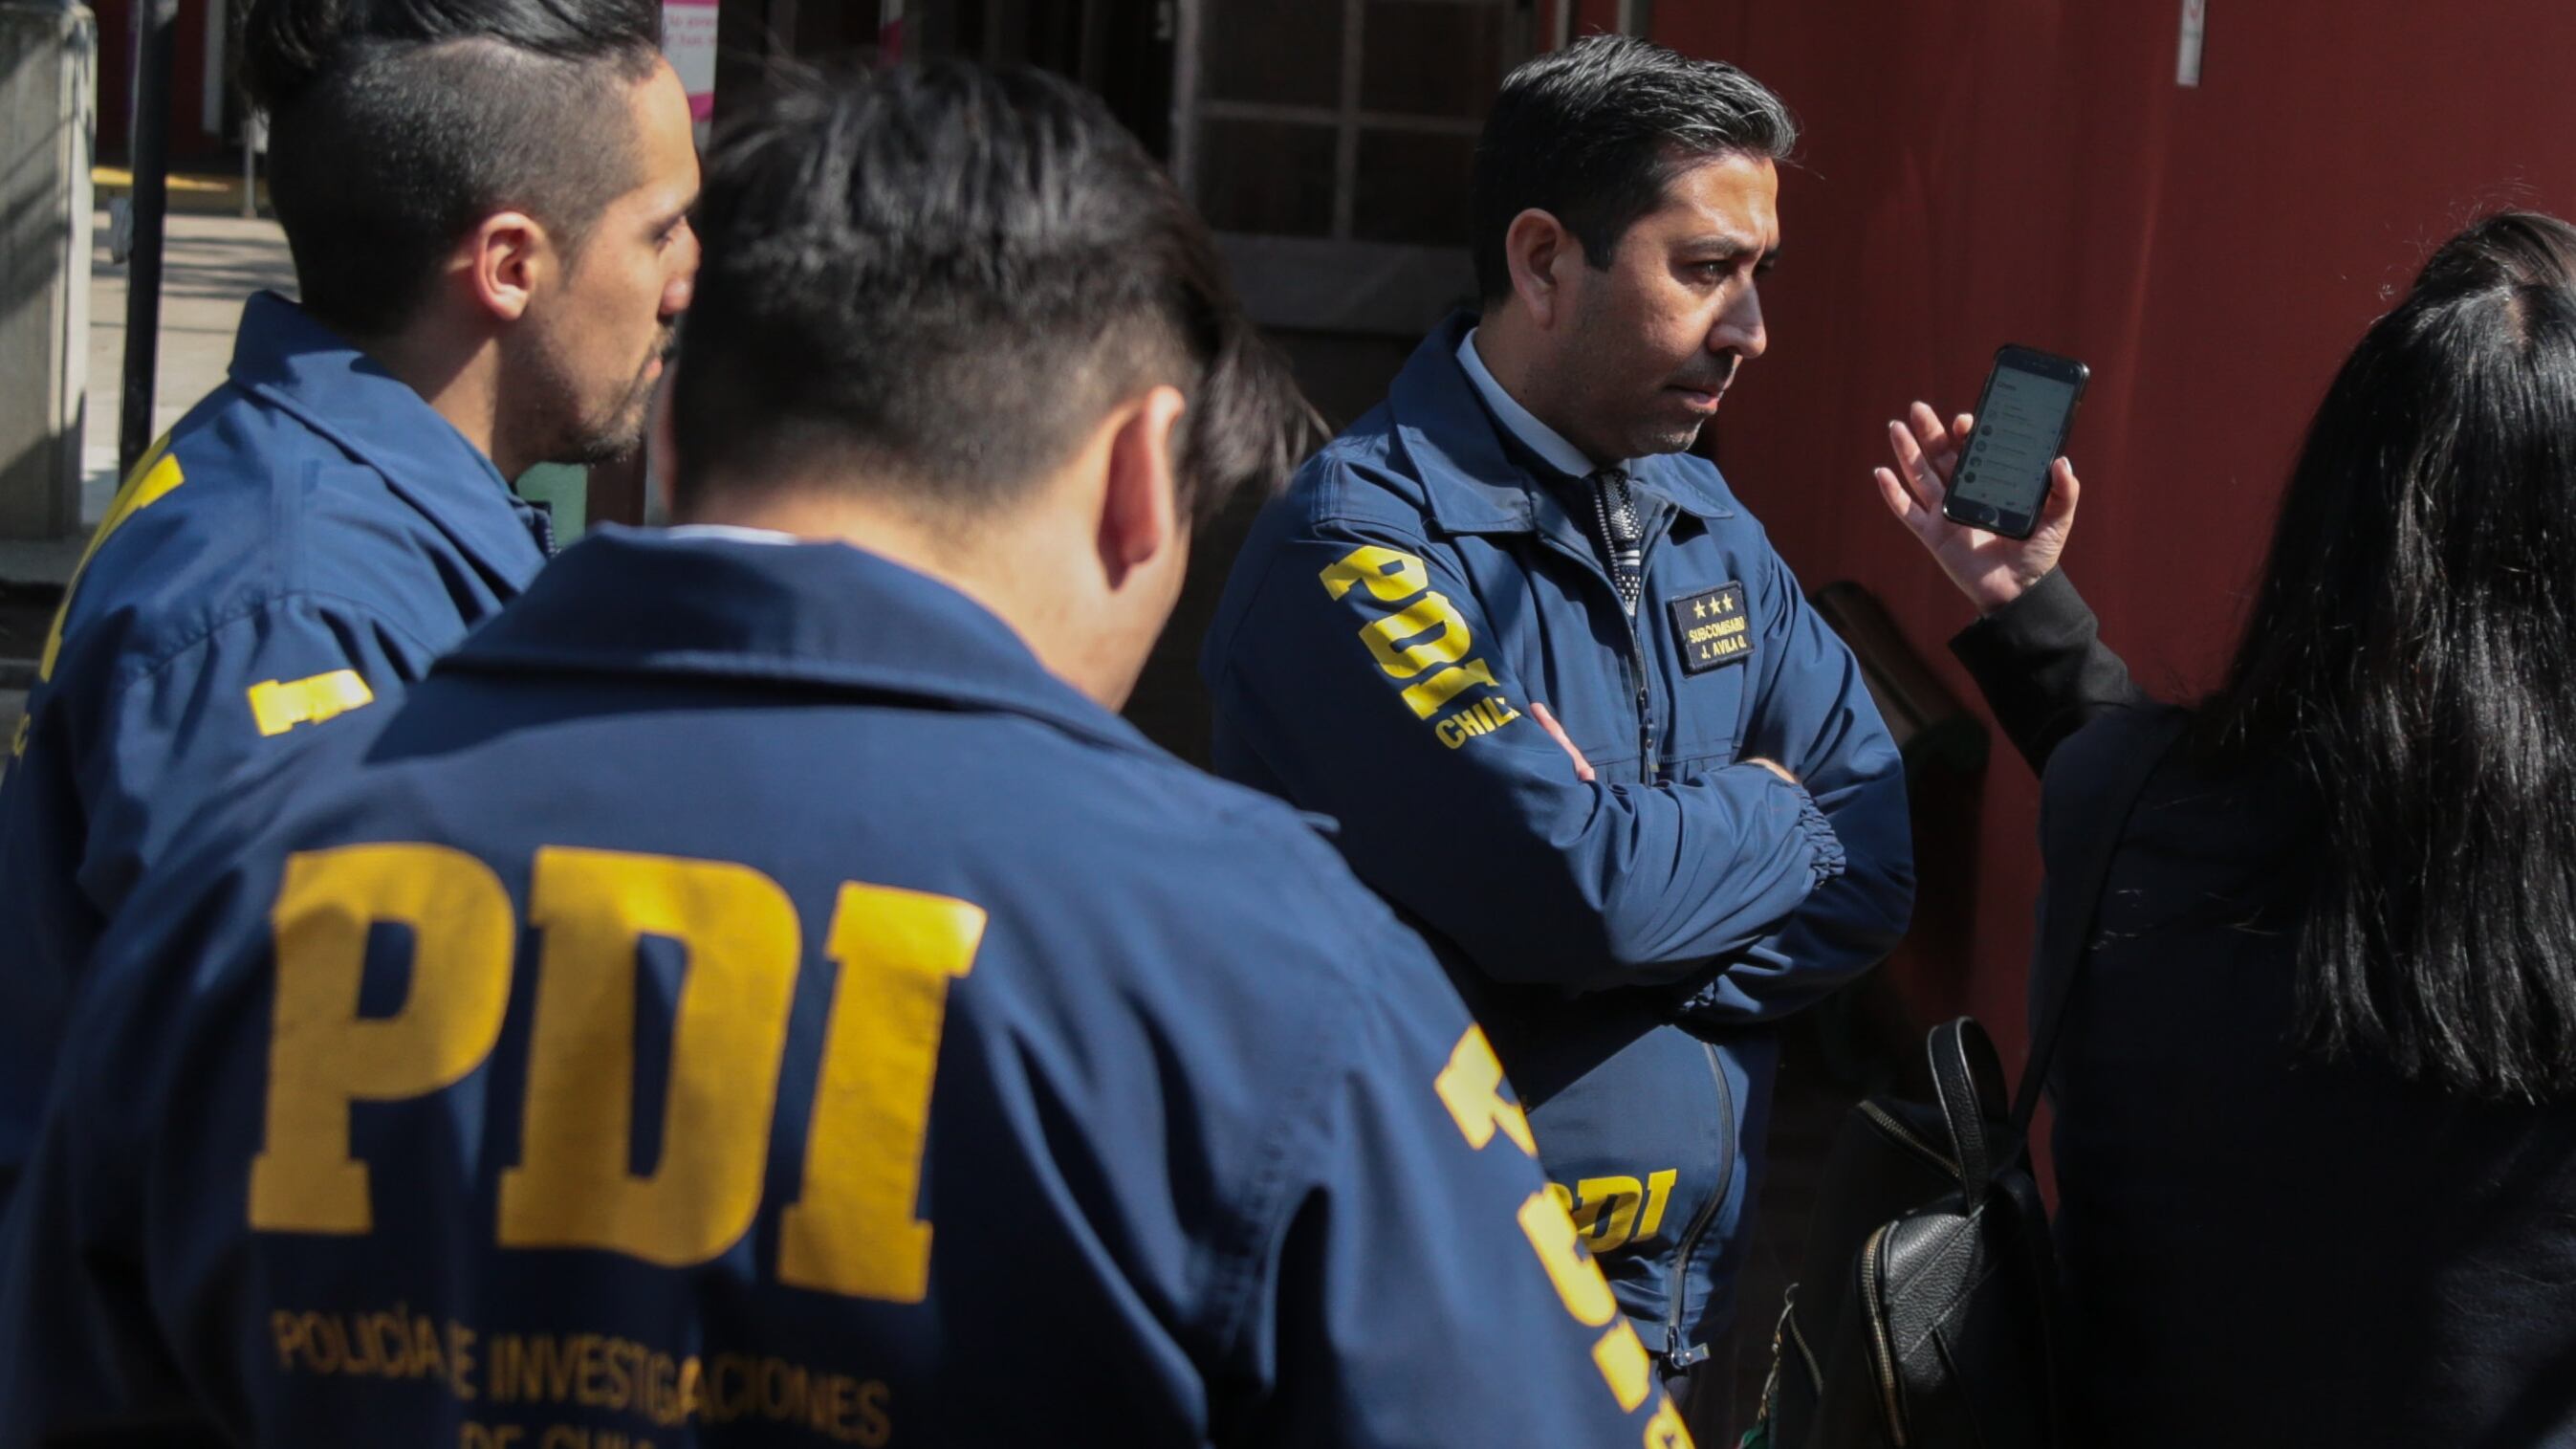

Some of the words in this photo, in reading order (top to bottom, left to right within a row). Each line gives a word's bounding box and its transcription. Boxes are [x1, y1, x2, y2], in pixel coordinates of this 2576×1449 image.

[1319, 545, 1499, 720] PDI
[1689, 617, 1745, 643] SUBCOMISARIO
[247, 841, 988, 1305] PDI
[1553, 1168, 1677, 1253] DI
